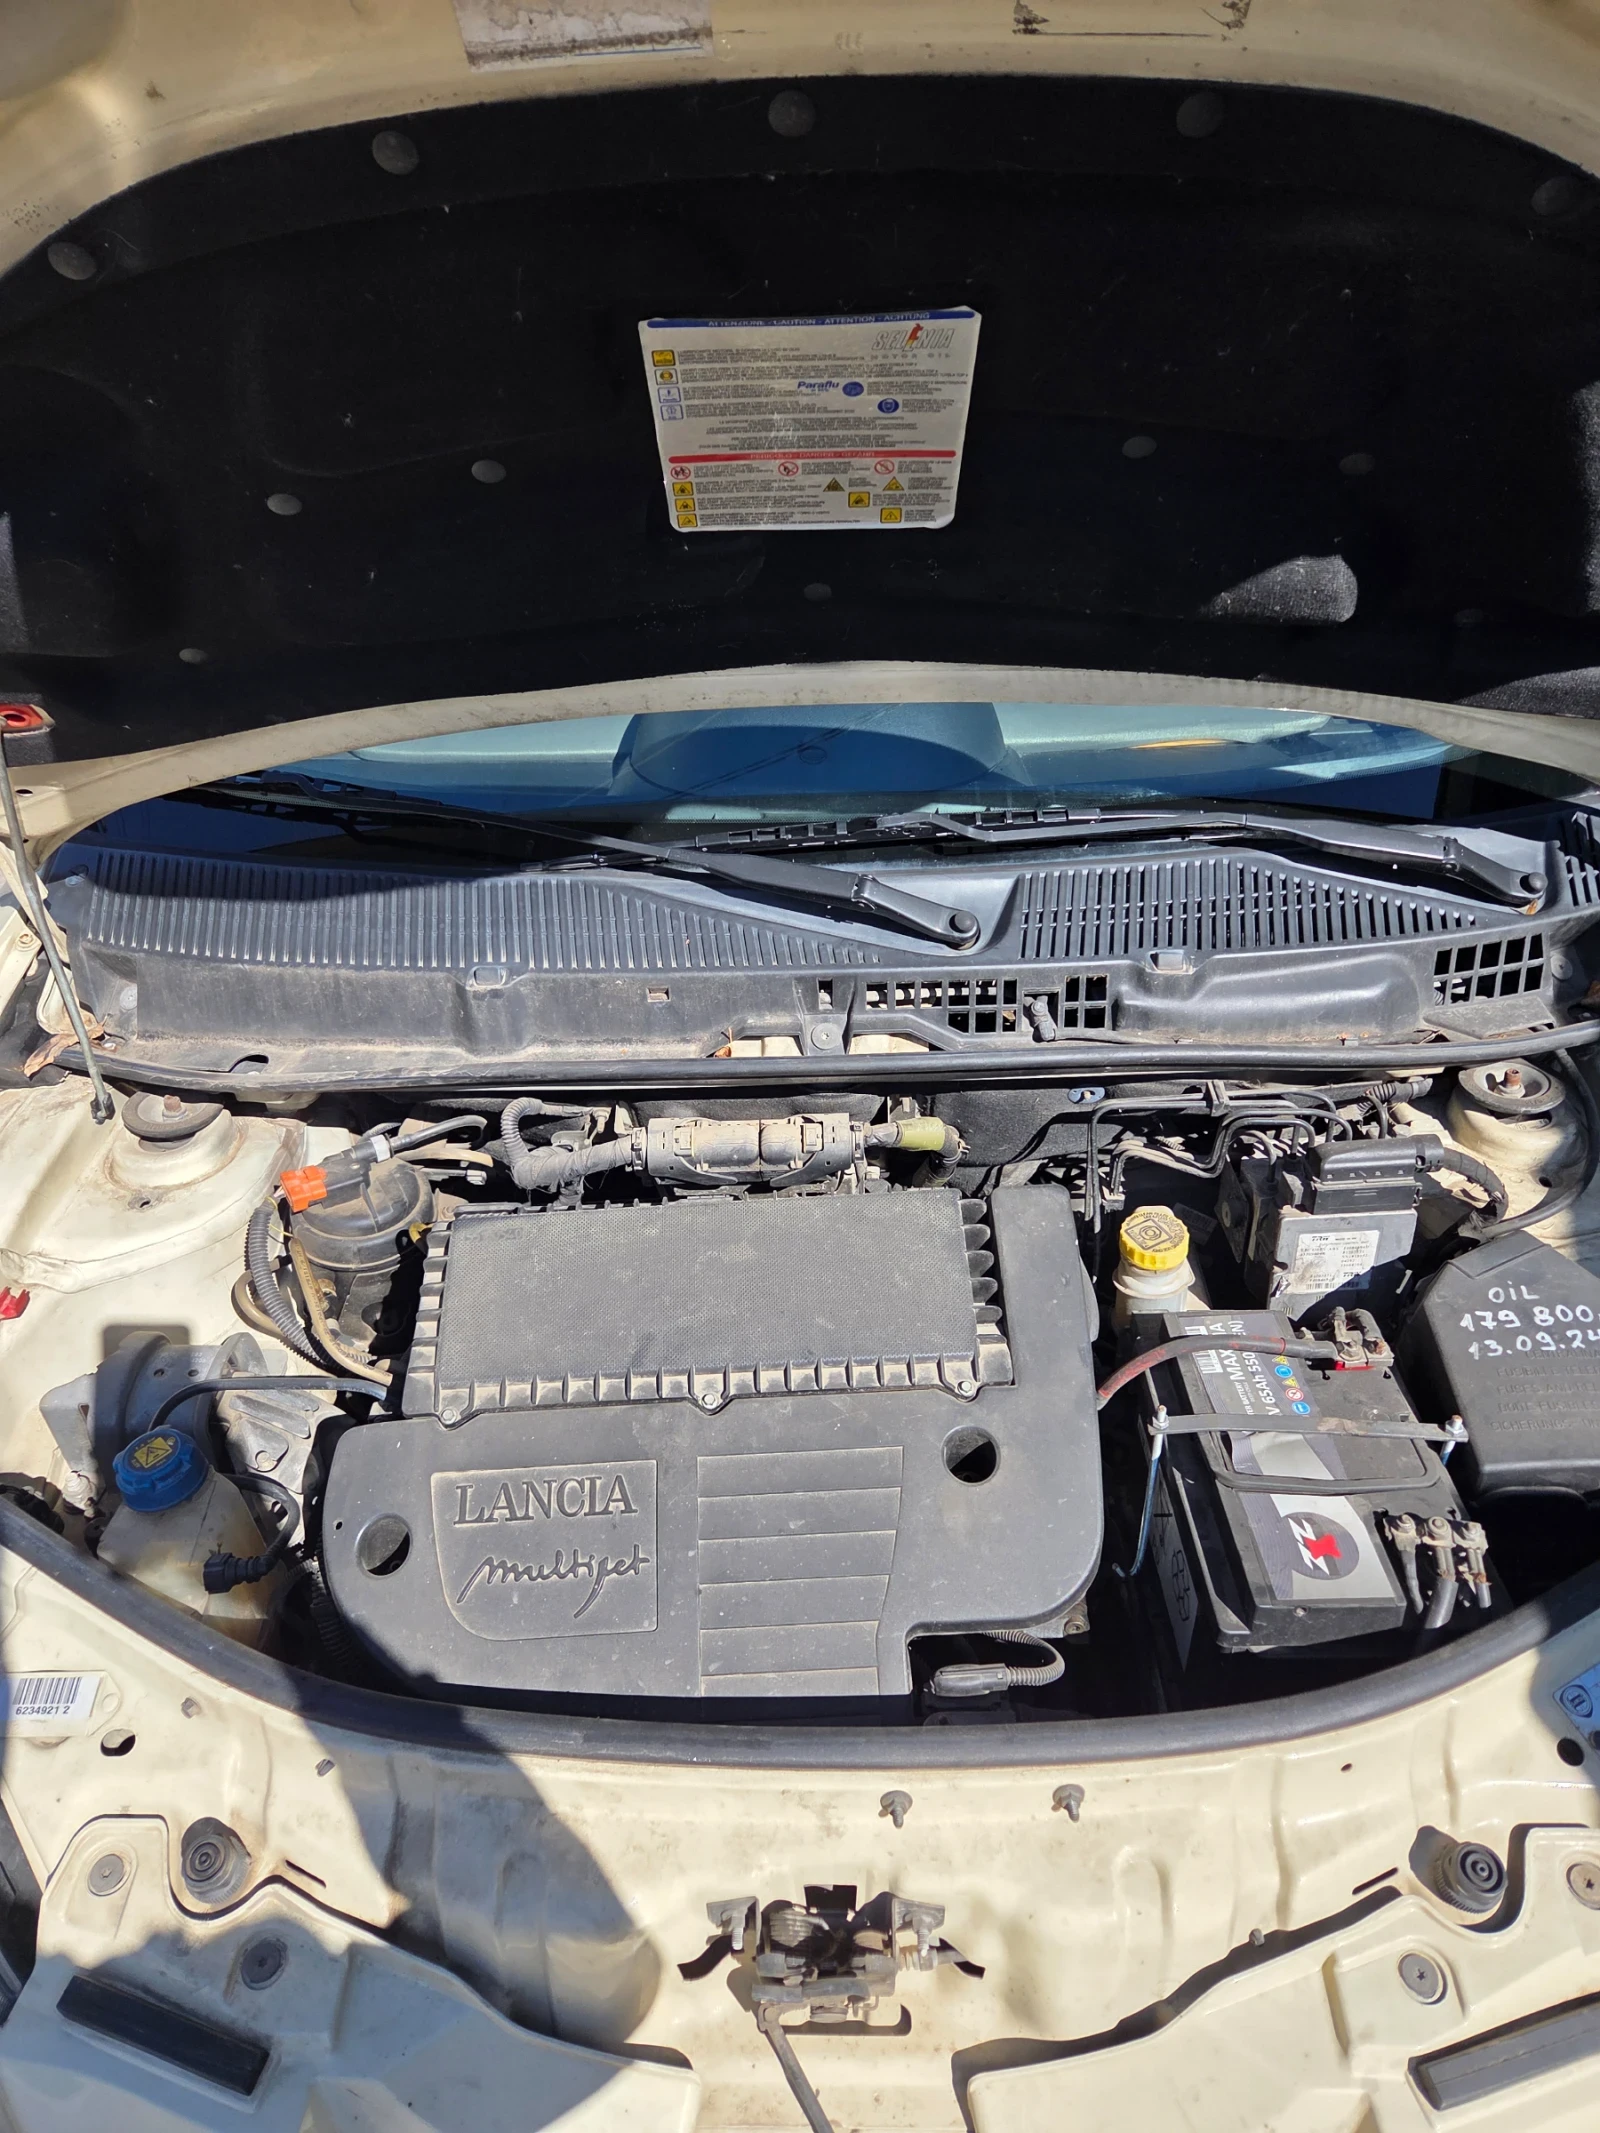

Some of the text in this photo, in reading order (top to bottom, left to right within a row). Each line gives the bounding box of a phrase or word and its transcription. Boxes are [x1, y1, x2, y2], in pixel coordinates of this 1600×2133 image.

[773, 318, 816, 326] CAUTION
[824, 315, 876, 324] ATTENTION
[884, 312, 930, 320] ACHTUNG
[871, 324, 955, 352] SELENIA
[797, 380, 840, 390] Paraflu
[750, 452, 792, 460] PERICOLO
[841, 450, 875, 458] GEFAHR
[1459, 1309, 1521, 1332] 179
[1233, 1381, 1250, 1405] BATTERY
[1252, 1374, 1276, 1404] 65Ah
[453, 1473, 639, 1527] LANCIA
[456, 1544, 651, 1620] multijet
[15, 1705, 71, 1715] 6234921 2
